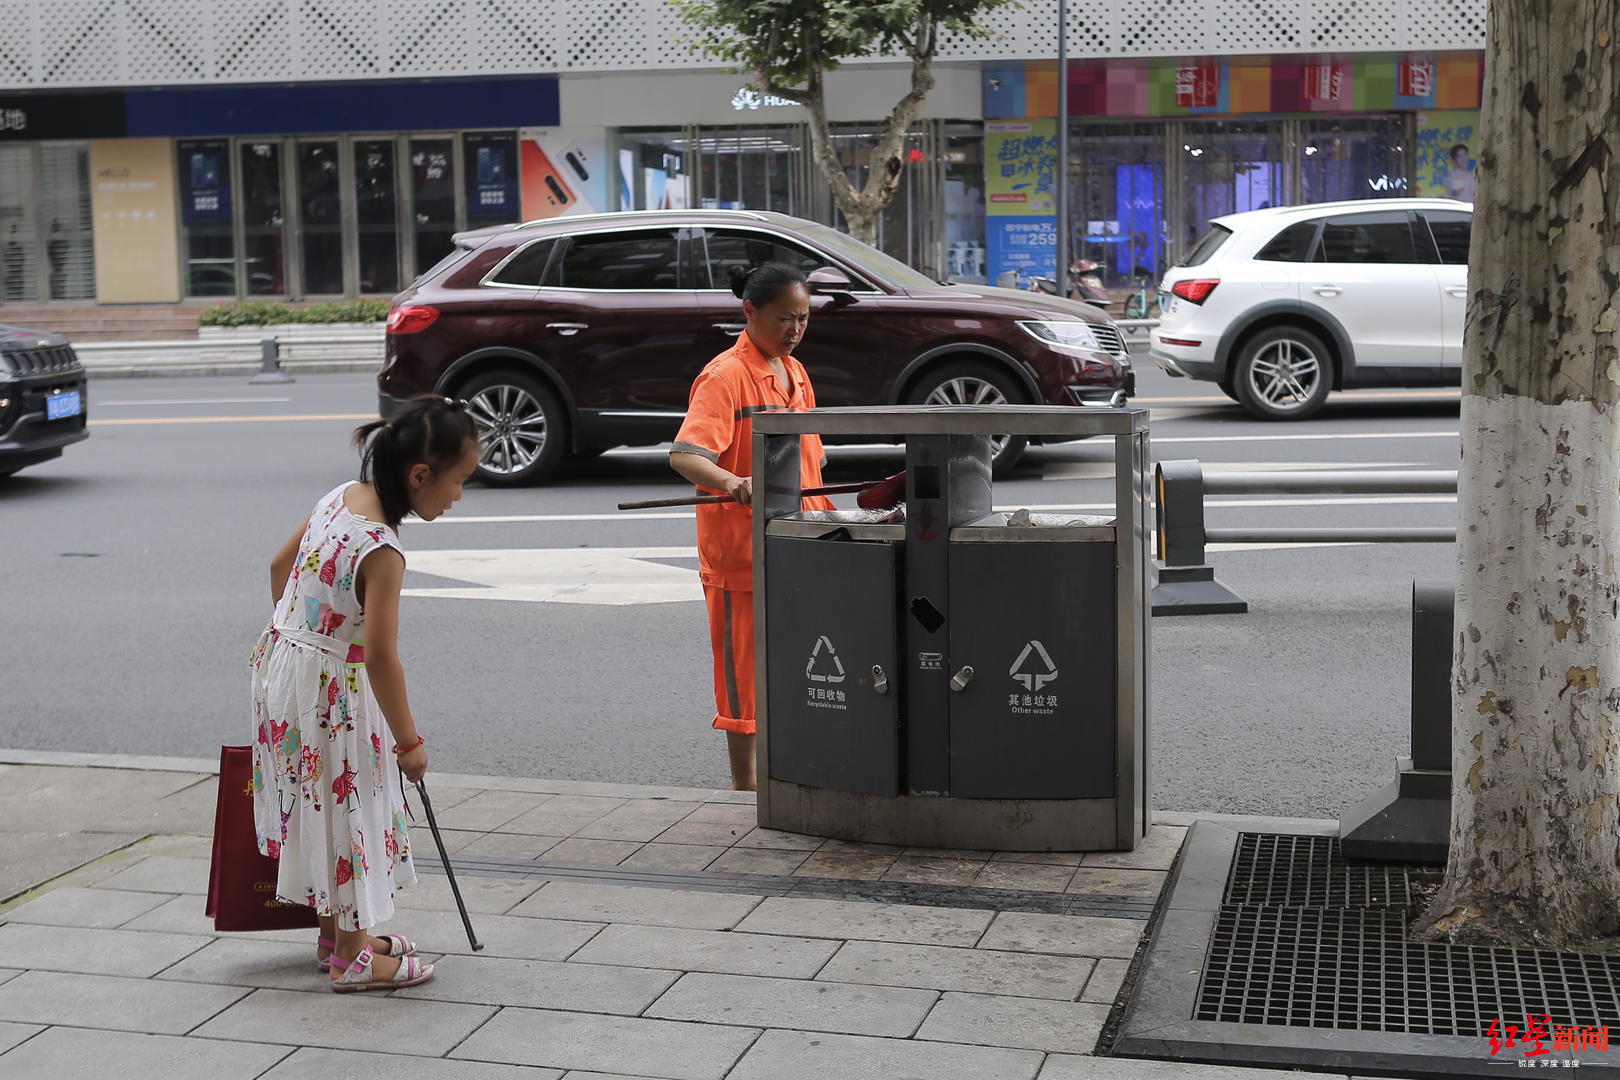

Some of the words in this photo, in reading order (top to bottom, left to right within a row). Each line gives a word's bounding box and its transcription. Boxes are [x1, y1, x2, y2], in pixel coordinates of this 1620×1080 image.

[807, 687, 846, 702] 可回收物
[1008, 694, 1058, 707] 其他垃圾
[1011, 706, 1032, 714] Other
